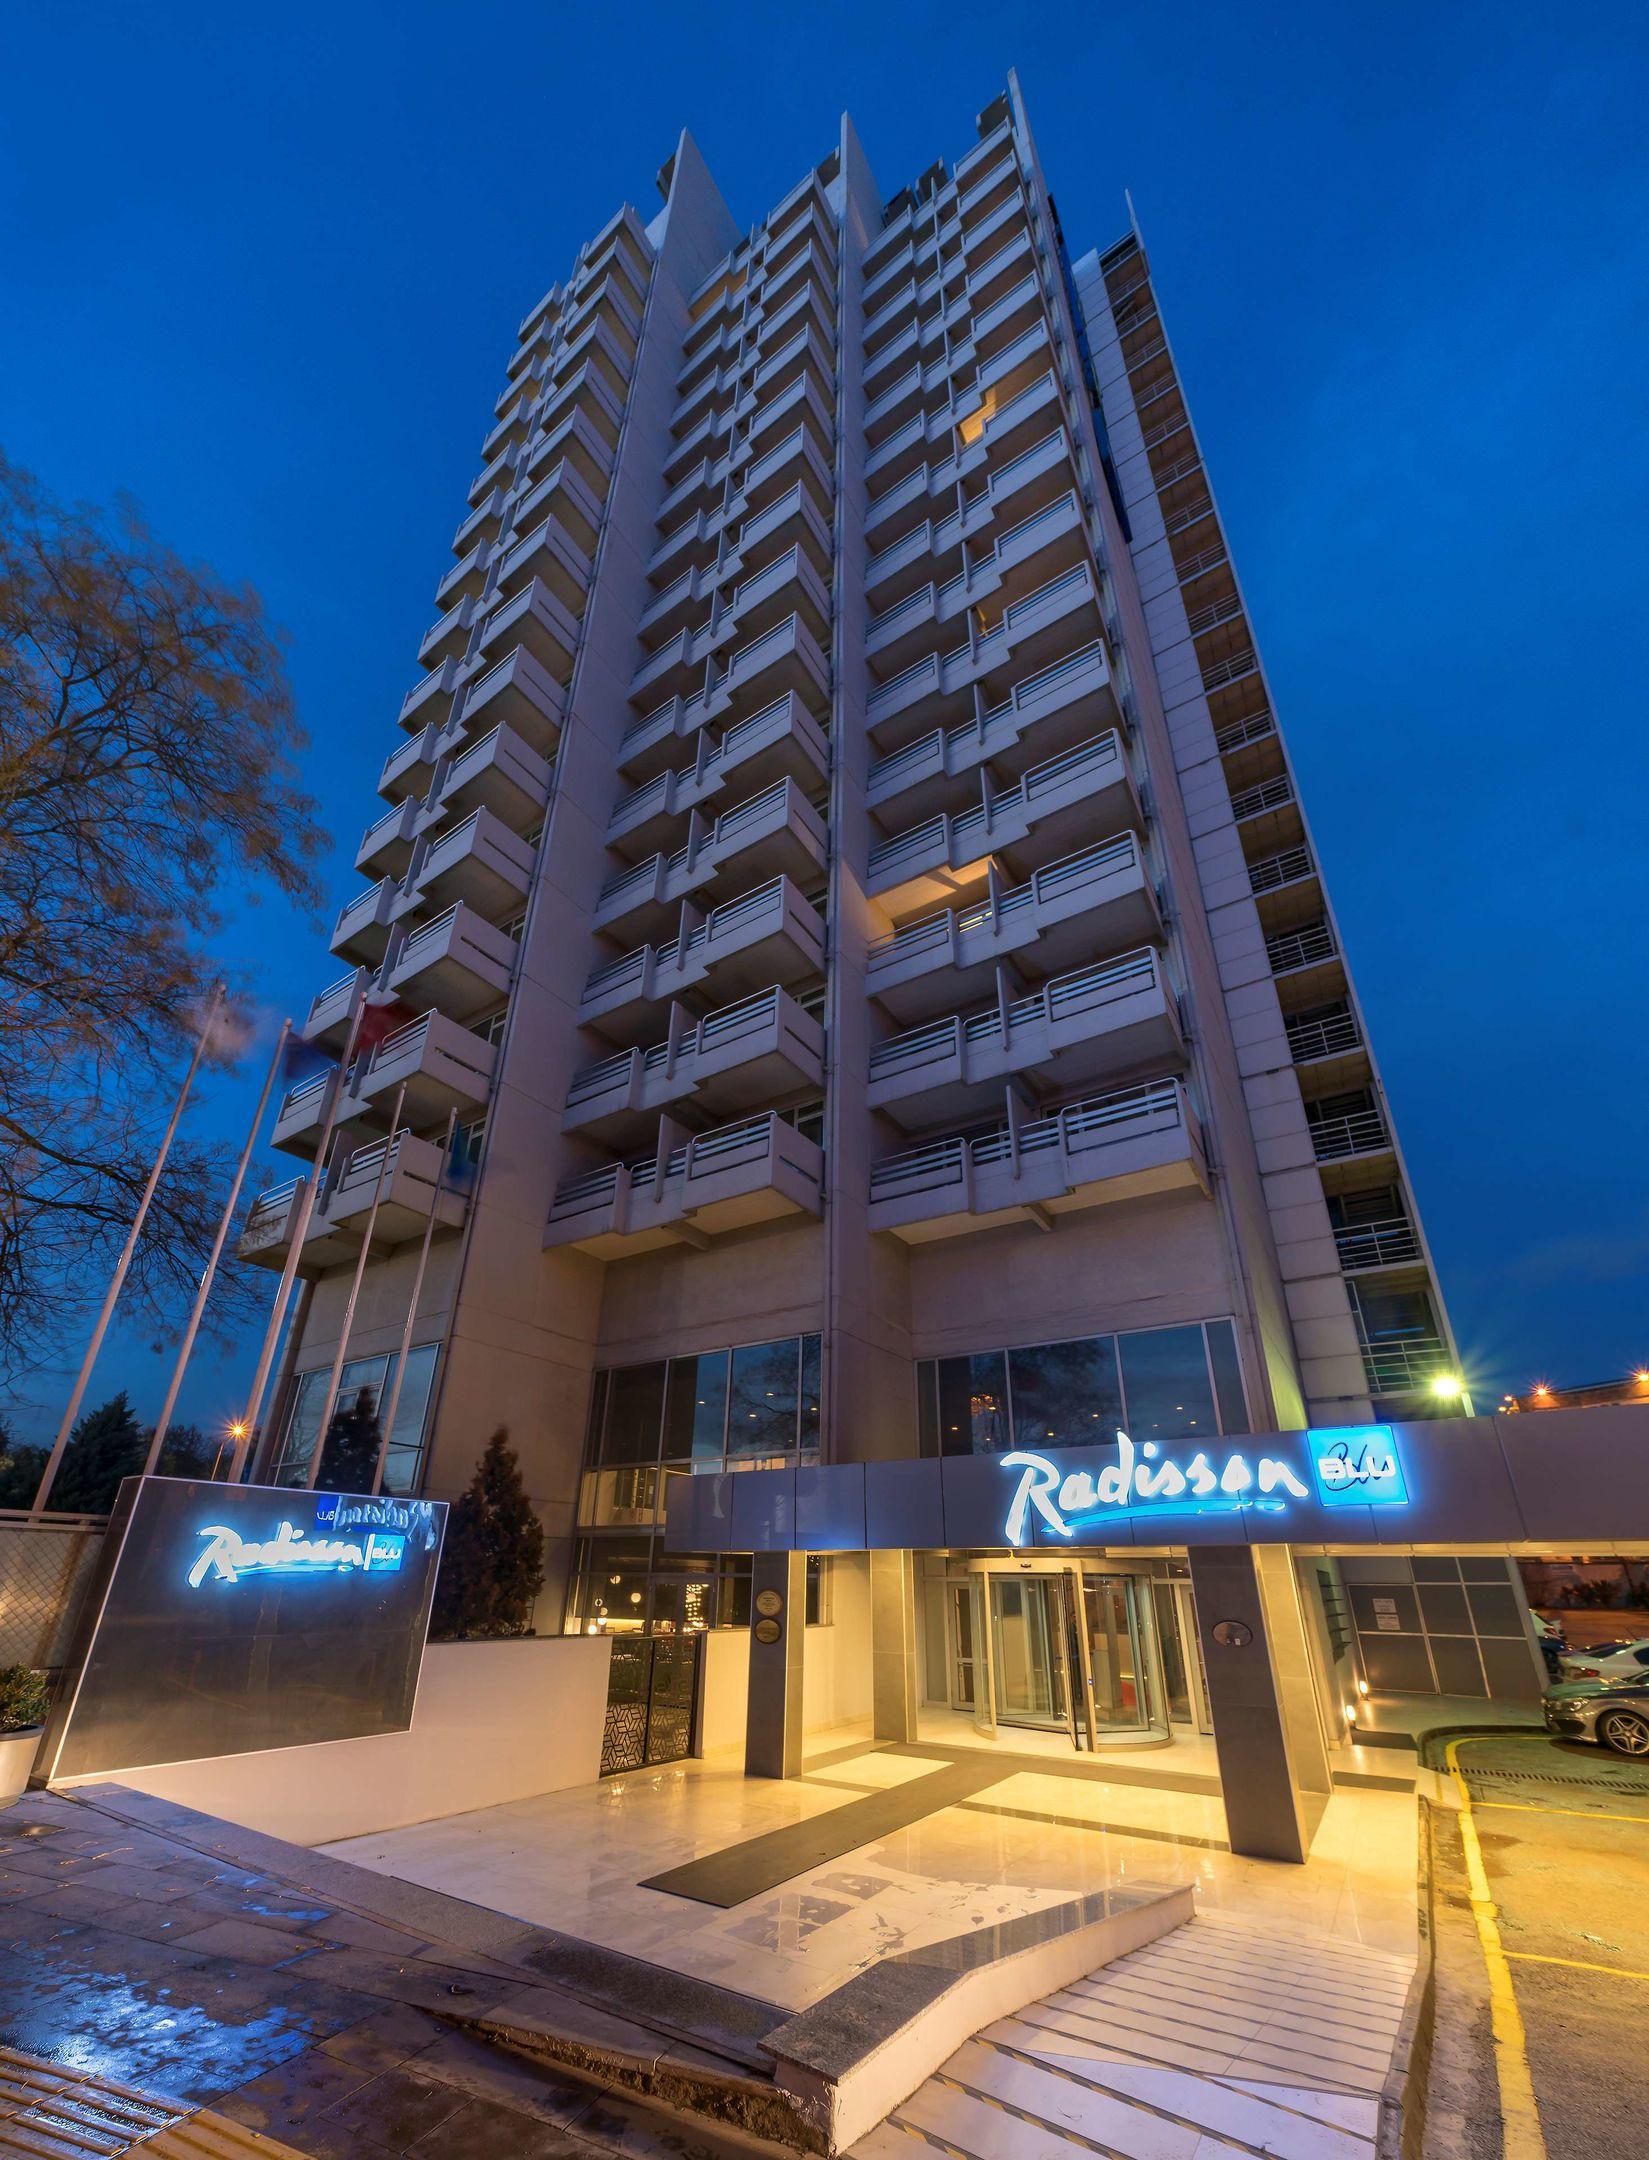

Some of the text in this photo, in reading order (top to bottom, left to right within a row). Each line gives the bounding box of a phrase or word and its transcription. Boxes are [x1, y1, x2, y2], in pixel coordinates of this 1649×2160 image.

[1000, 1430, 1396, 1546] Radisson BLU
[187, 1521, 363, 1588] Radisson
